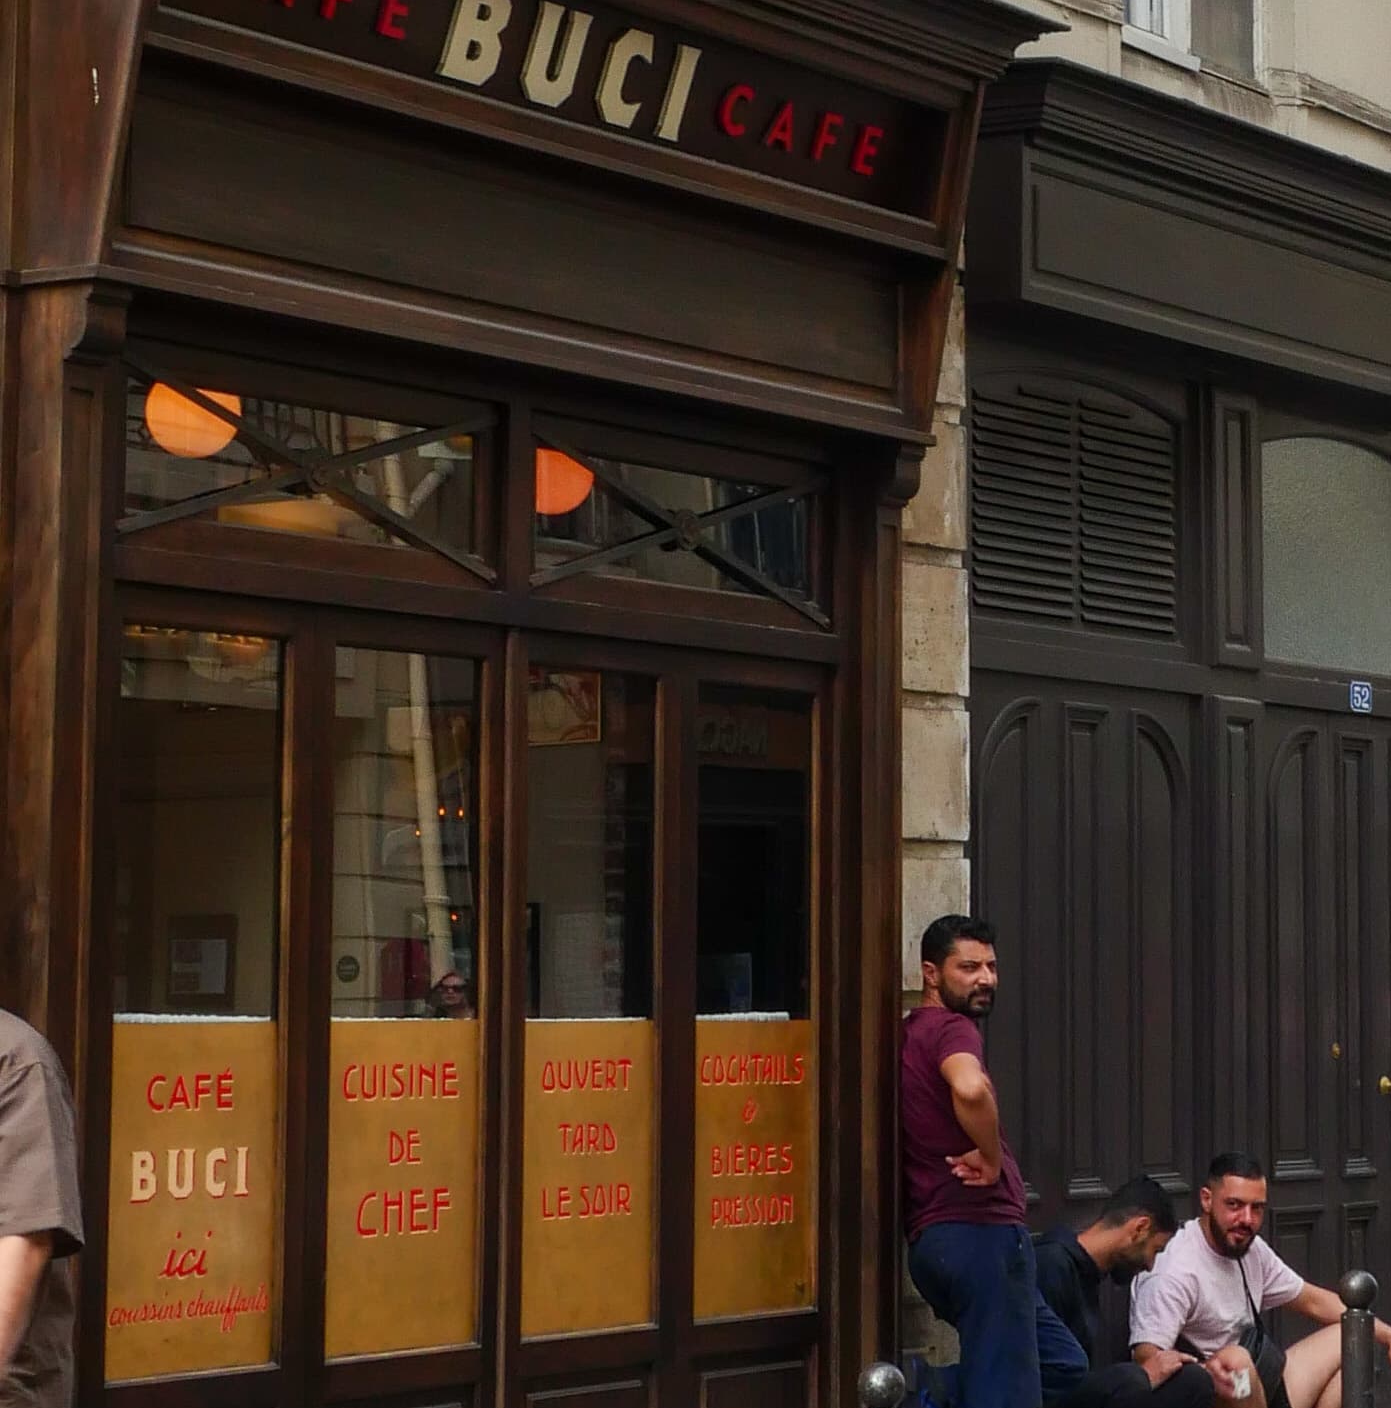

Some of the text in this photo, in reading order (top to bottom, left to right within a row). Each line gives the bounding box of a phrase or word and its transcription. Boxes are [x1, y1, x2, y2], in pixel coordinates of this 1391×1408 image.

[719, 83, 885, 176] CAFE
[1353, 686, 1370, 709] 52
[342, 1063, 460, 1102] CUISINE
[542, 1058, 632, 1093] OUVERT
[700, 1053, 805, 1086] COCKTAILS
[146, 1066, 234, 1113] CAFÉ
[388, 1128, 421, 1166] DE
[558, 1122, 618, 1155] TARD
[129, 1146, 249, 1204] BUCI
[356, 1187, 452, 1239] CHEF
[541, 1182, 632, 1220] LE SOIR
[711, 1193, 794, 1229] PRESSION
[157, 1229, 214, 1280] ici
